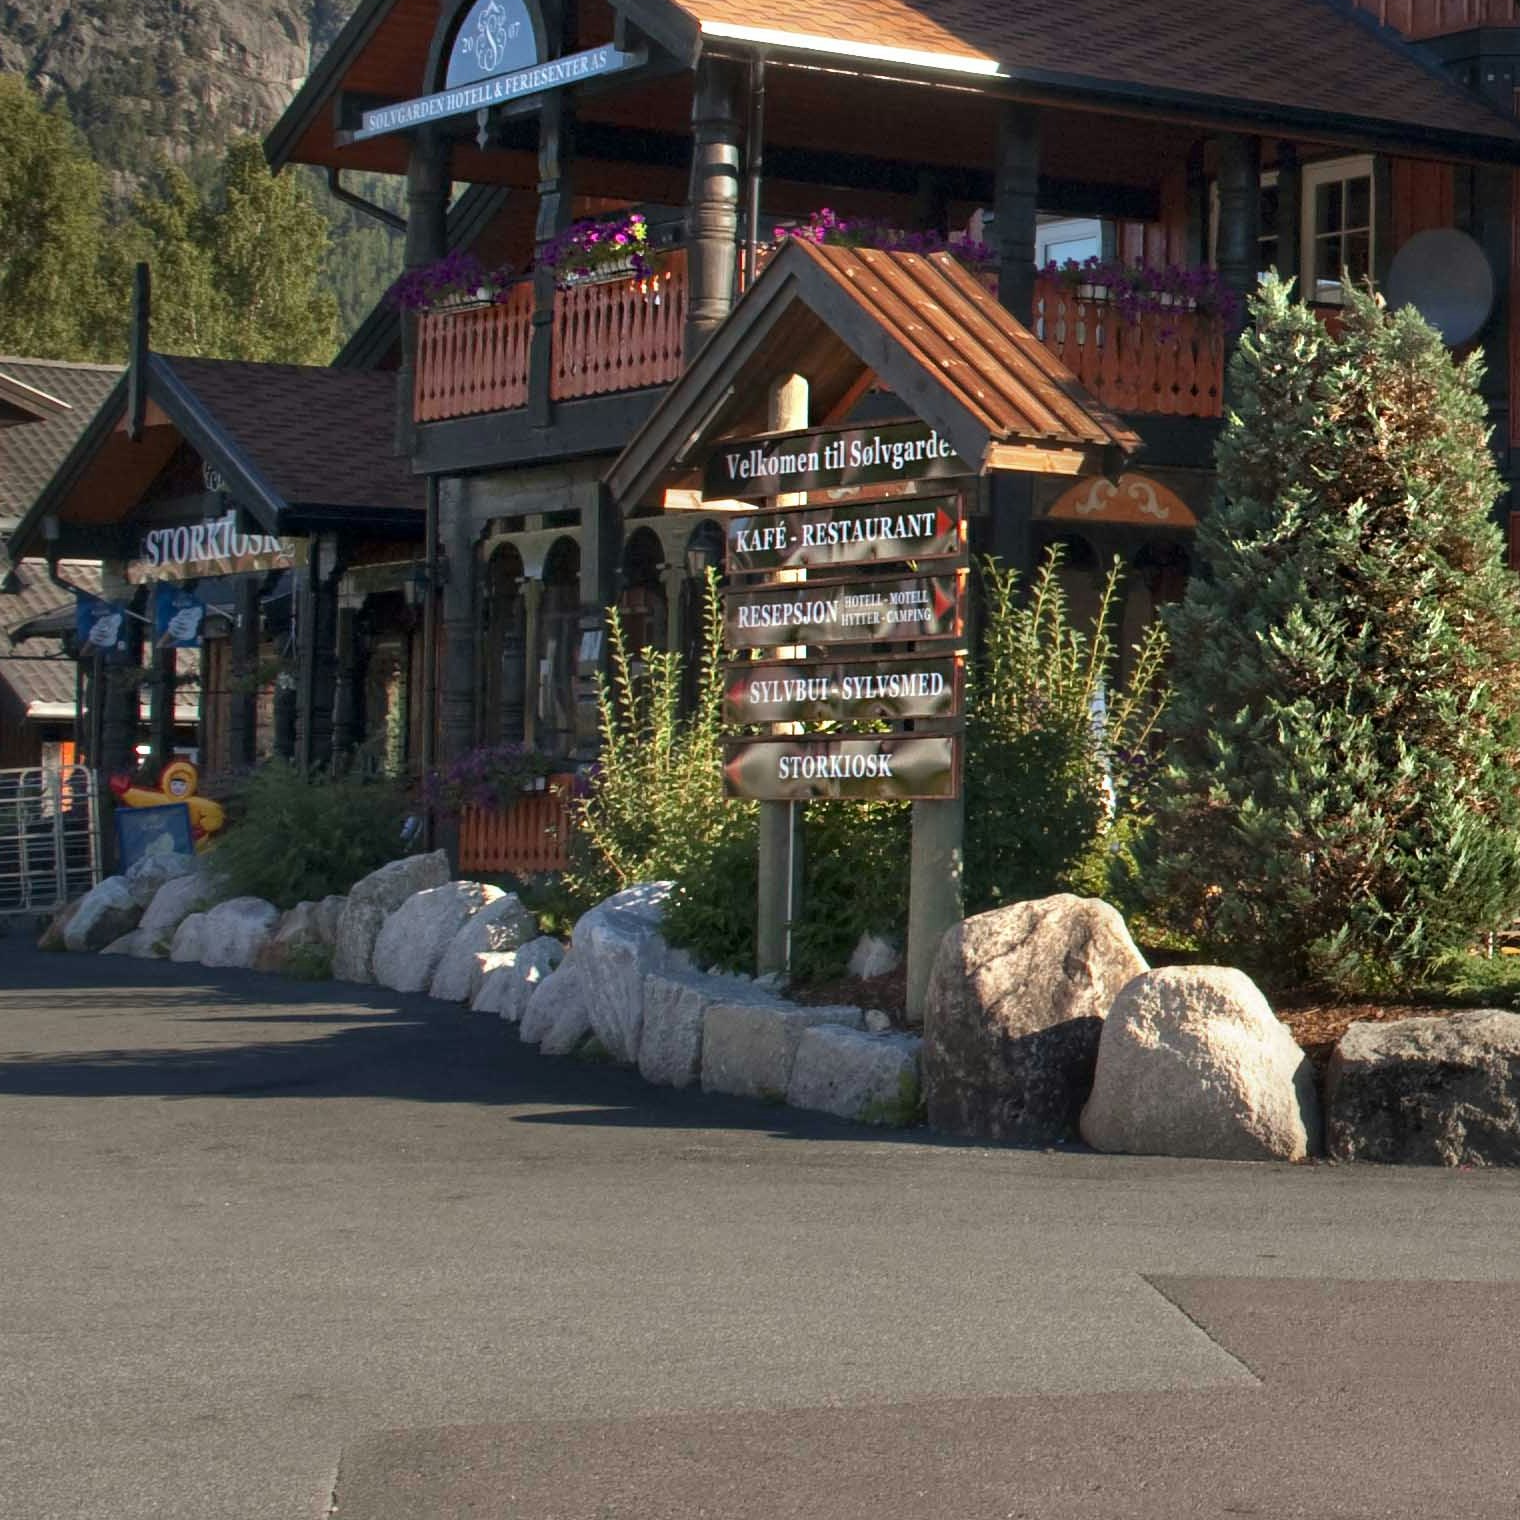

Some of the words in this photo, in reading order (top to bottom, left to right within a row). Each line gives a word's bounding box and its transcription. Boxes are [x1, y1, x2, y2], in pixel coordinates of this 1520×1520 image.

[462, 37, 474, 54] 20
[446, 83, 493, 114] HOTELL
[494, 82, 503, 98] &
[505, 56, 590, 95] FERIESENTER
[590, 50, 608, 71] AS
[726, 449, 819, 480] Velkomen
[824, 440, 846, 469] til
[850, 430, 957, 469] Sølvgarde
[736, 523, 787, 553] KAFÉ
[802, 512, 935, 547] RESTAURANT
[844, 593, 883, 608] HOTELL
[890, 590, 929, 604] MOTELL
[738, 600, 839, 628] RESEPSJON
[841, 611, 880, 626] HYTTER
[887, 608, 931, 624] CAMPING
[750, 678, 828, 704] SYLVBUI
[842, 672, 944, 700] SYLVSMED
[778, 754, 893, 779] STORKIOSK
